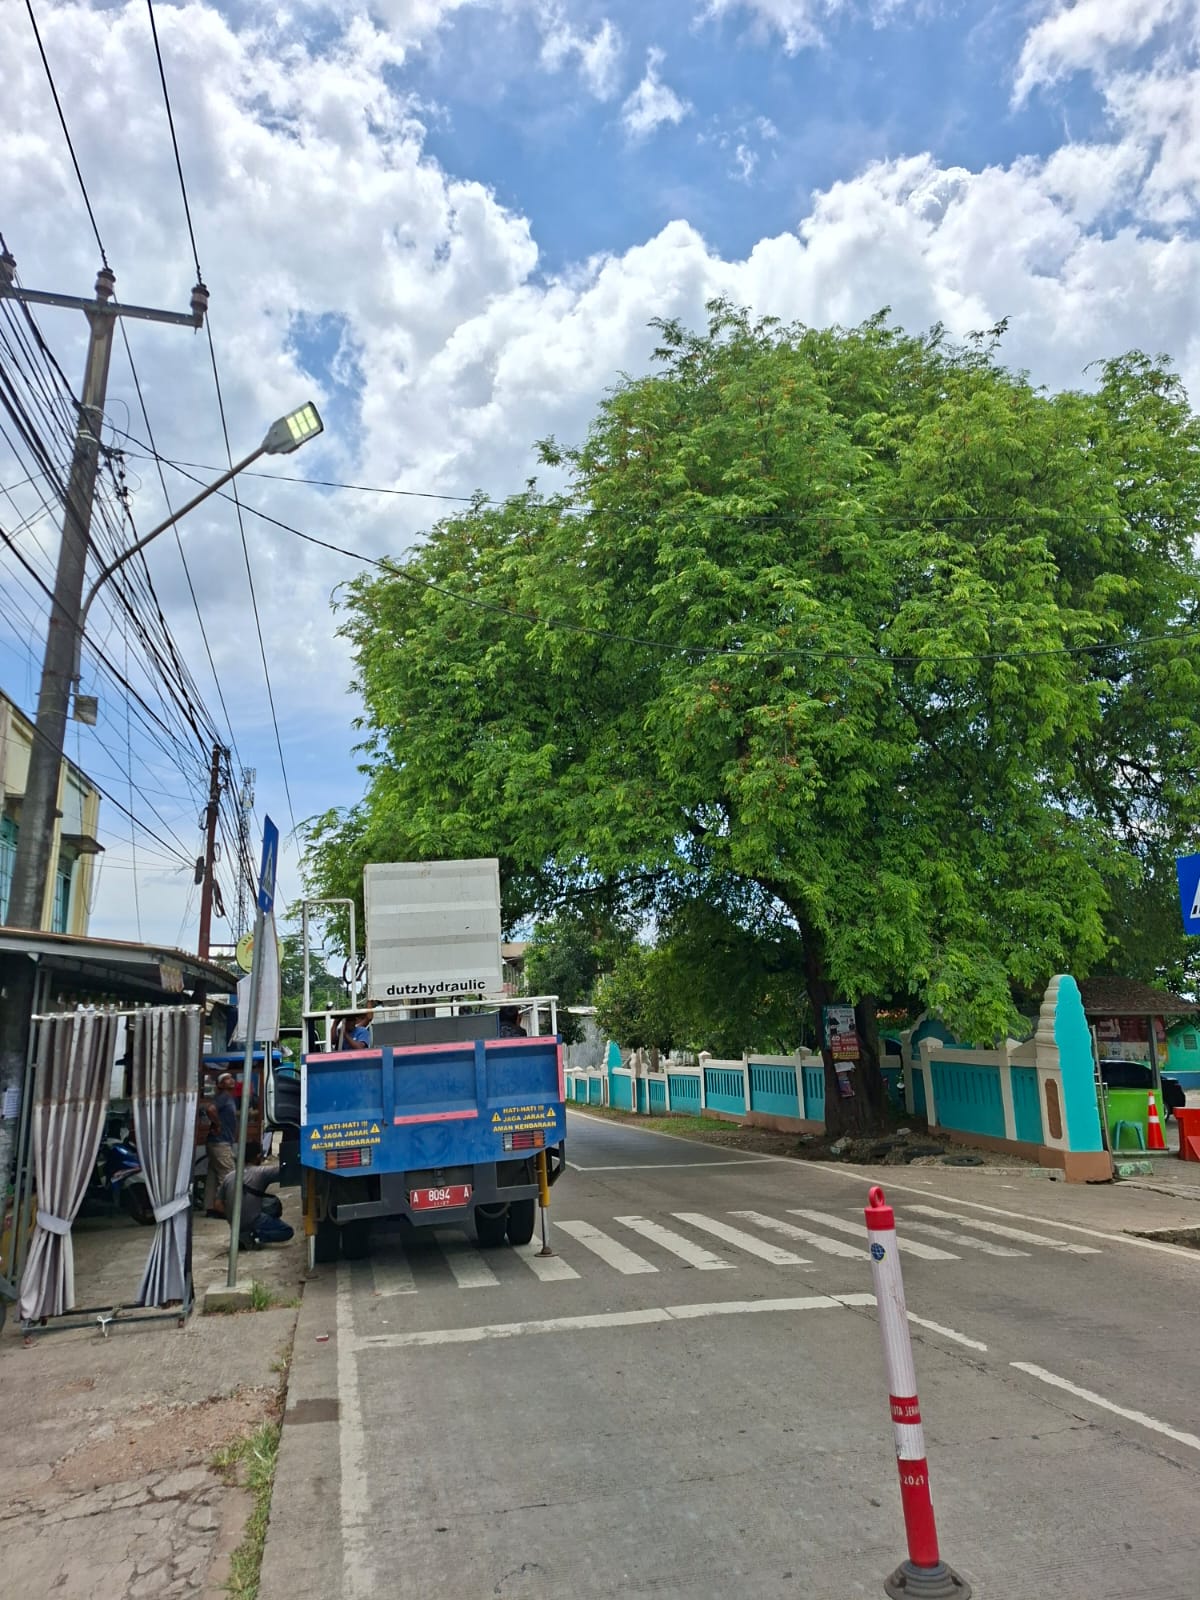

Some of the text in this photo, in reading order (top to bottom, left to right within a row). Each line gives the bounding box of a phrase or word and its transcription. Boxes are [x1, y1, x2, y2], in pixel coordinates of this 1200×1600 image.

[386, 979, 486, 996] dutzhydraulic
[503, 1105, 536, 1114] HATI-HATI
[323, 1121, 359, 1130] HATI-HATI
[493, 1121, 557, 1133] AMAN KENDARAAN
[344, 1129, 369, 1137] JARAK
[335, 1137, 381, 1147] KENDARAAN
[413, 1186, 470, 1203] A 8094 A
[903, 1475, 925, 1486] 2023
